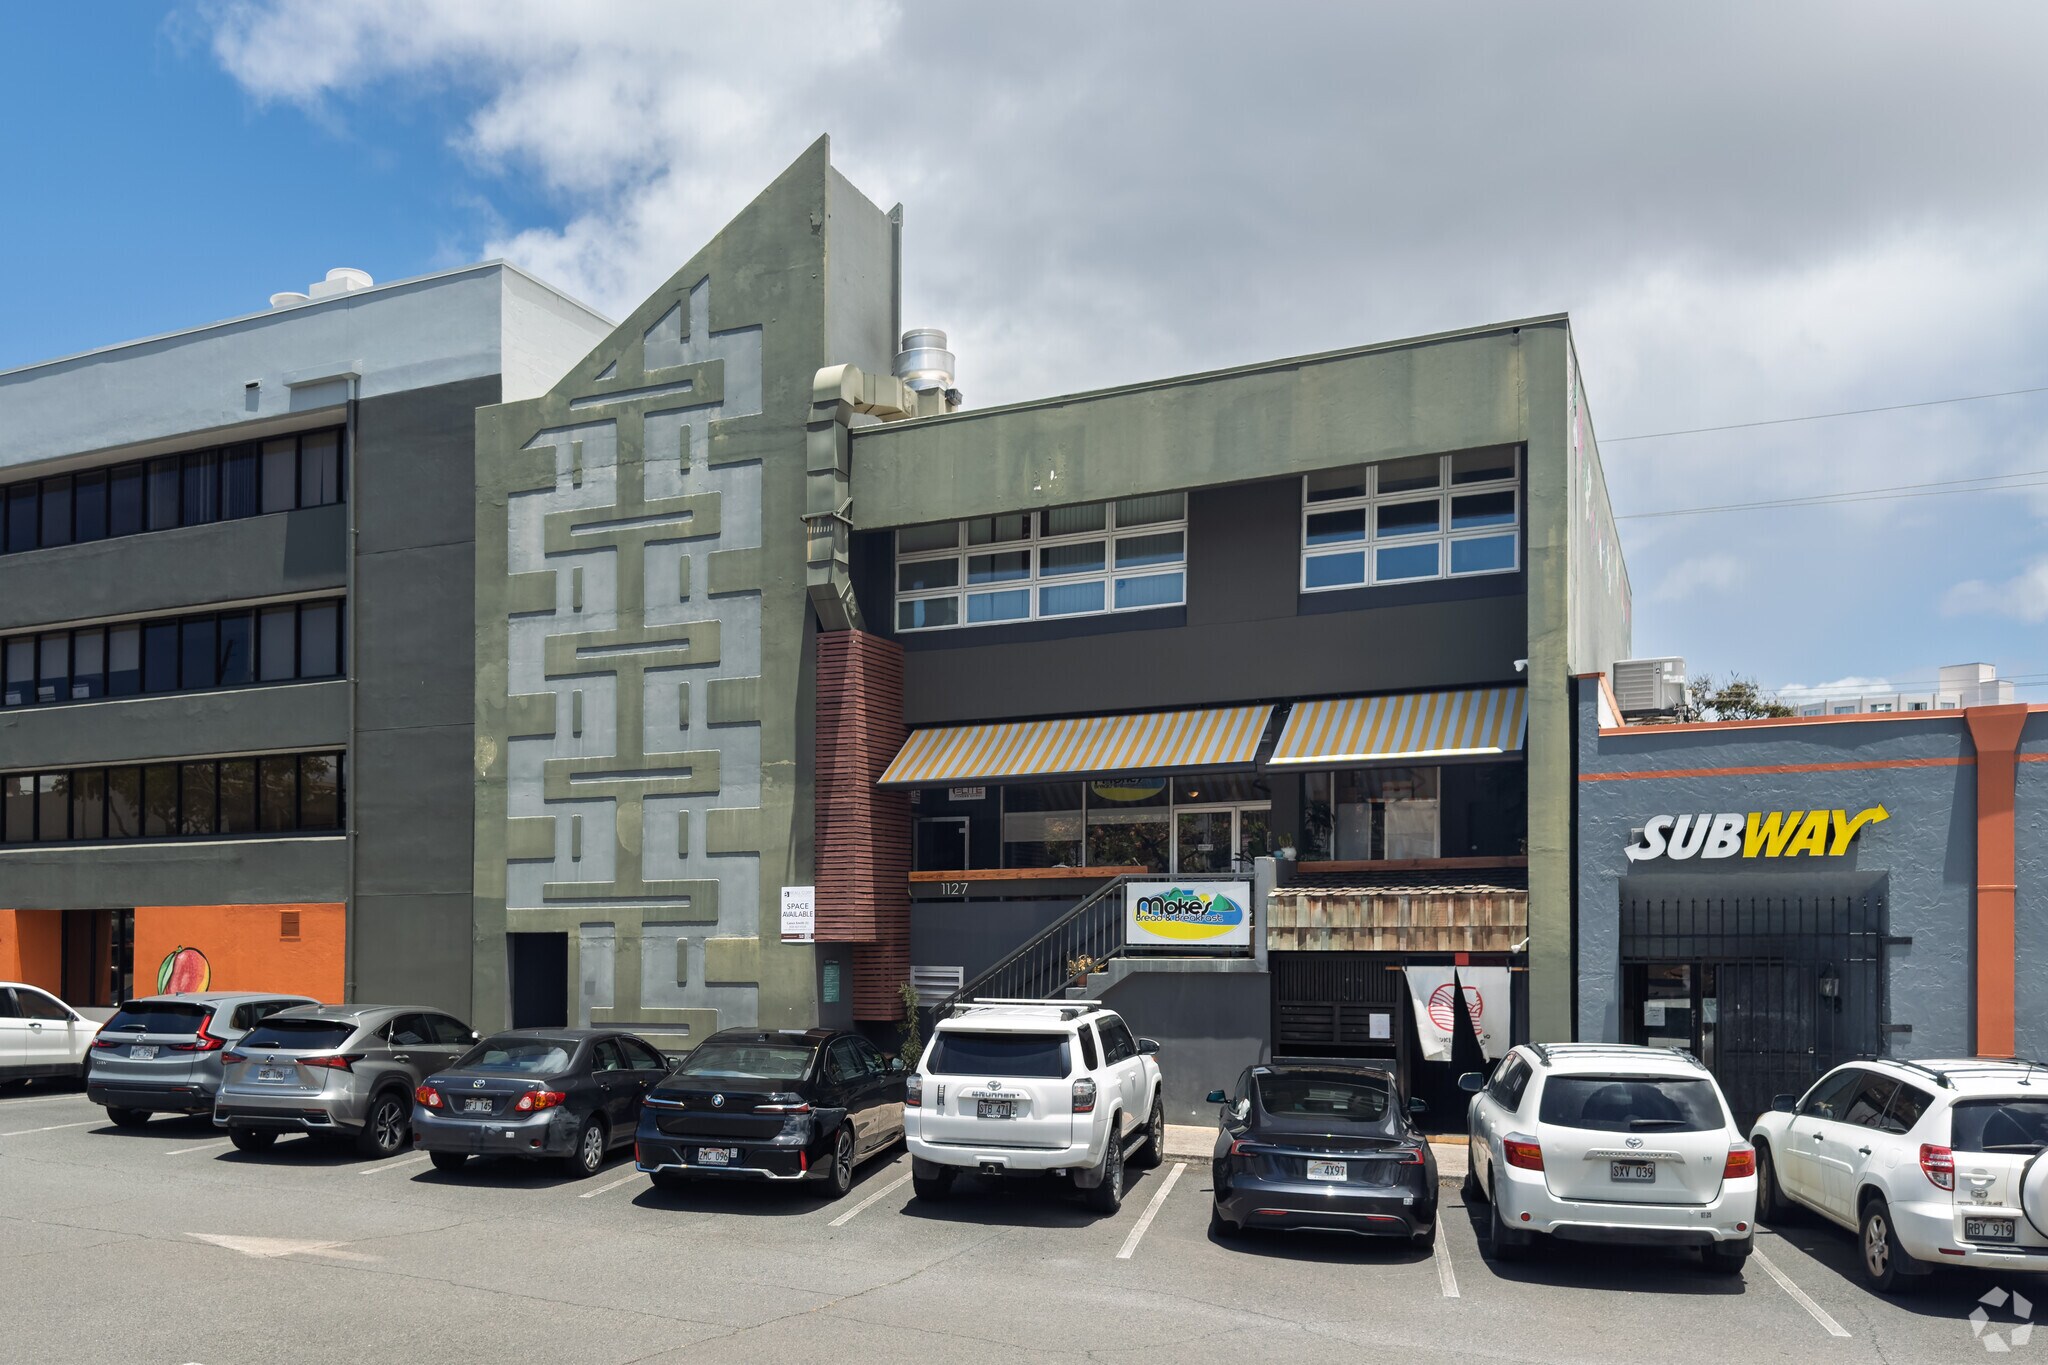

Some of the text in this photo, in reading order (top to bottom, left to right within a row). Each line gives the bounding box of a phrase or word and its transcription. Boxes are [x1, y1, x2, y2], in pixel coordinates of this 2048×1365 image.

[1623, 803, 1891, 863] SUBWAY
[941, 883, 969, 895] 1127
[1136, 896, 1213, 915] Moke's
[1136, 914, 1163, 922] Bread
[481, 1102, 492, 1111] 145
[979, 1104, 993, 1114] STB
[996, 1104, 1009, 1115] 471
[699, 1150, 712, 1160] ZMC
[716, 1151, 728, 1161] 096
[1324, 1165, 1345, 1176] 4X97
[1613, 1166, 1653, 1178] SXV 039
[1967, 1223, 2013, 1236] RBY 919
